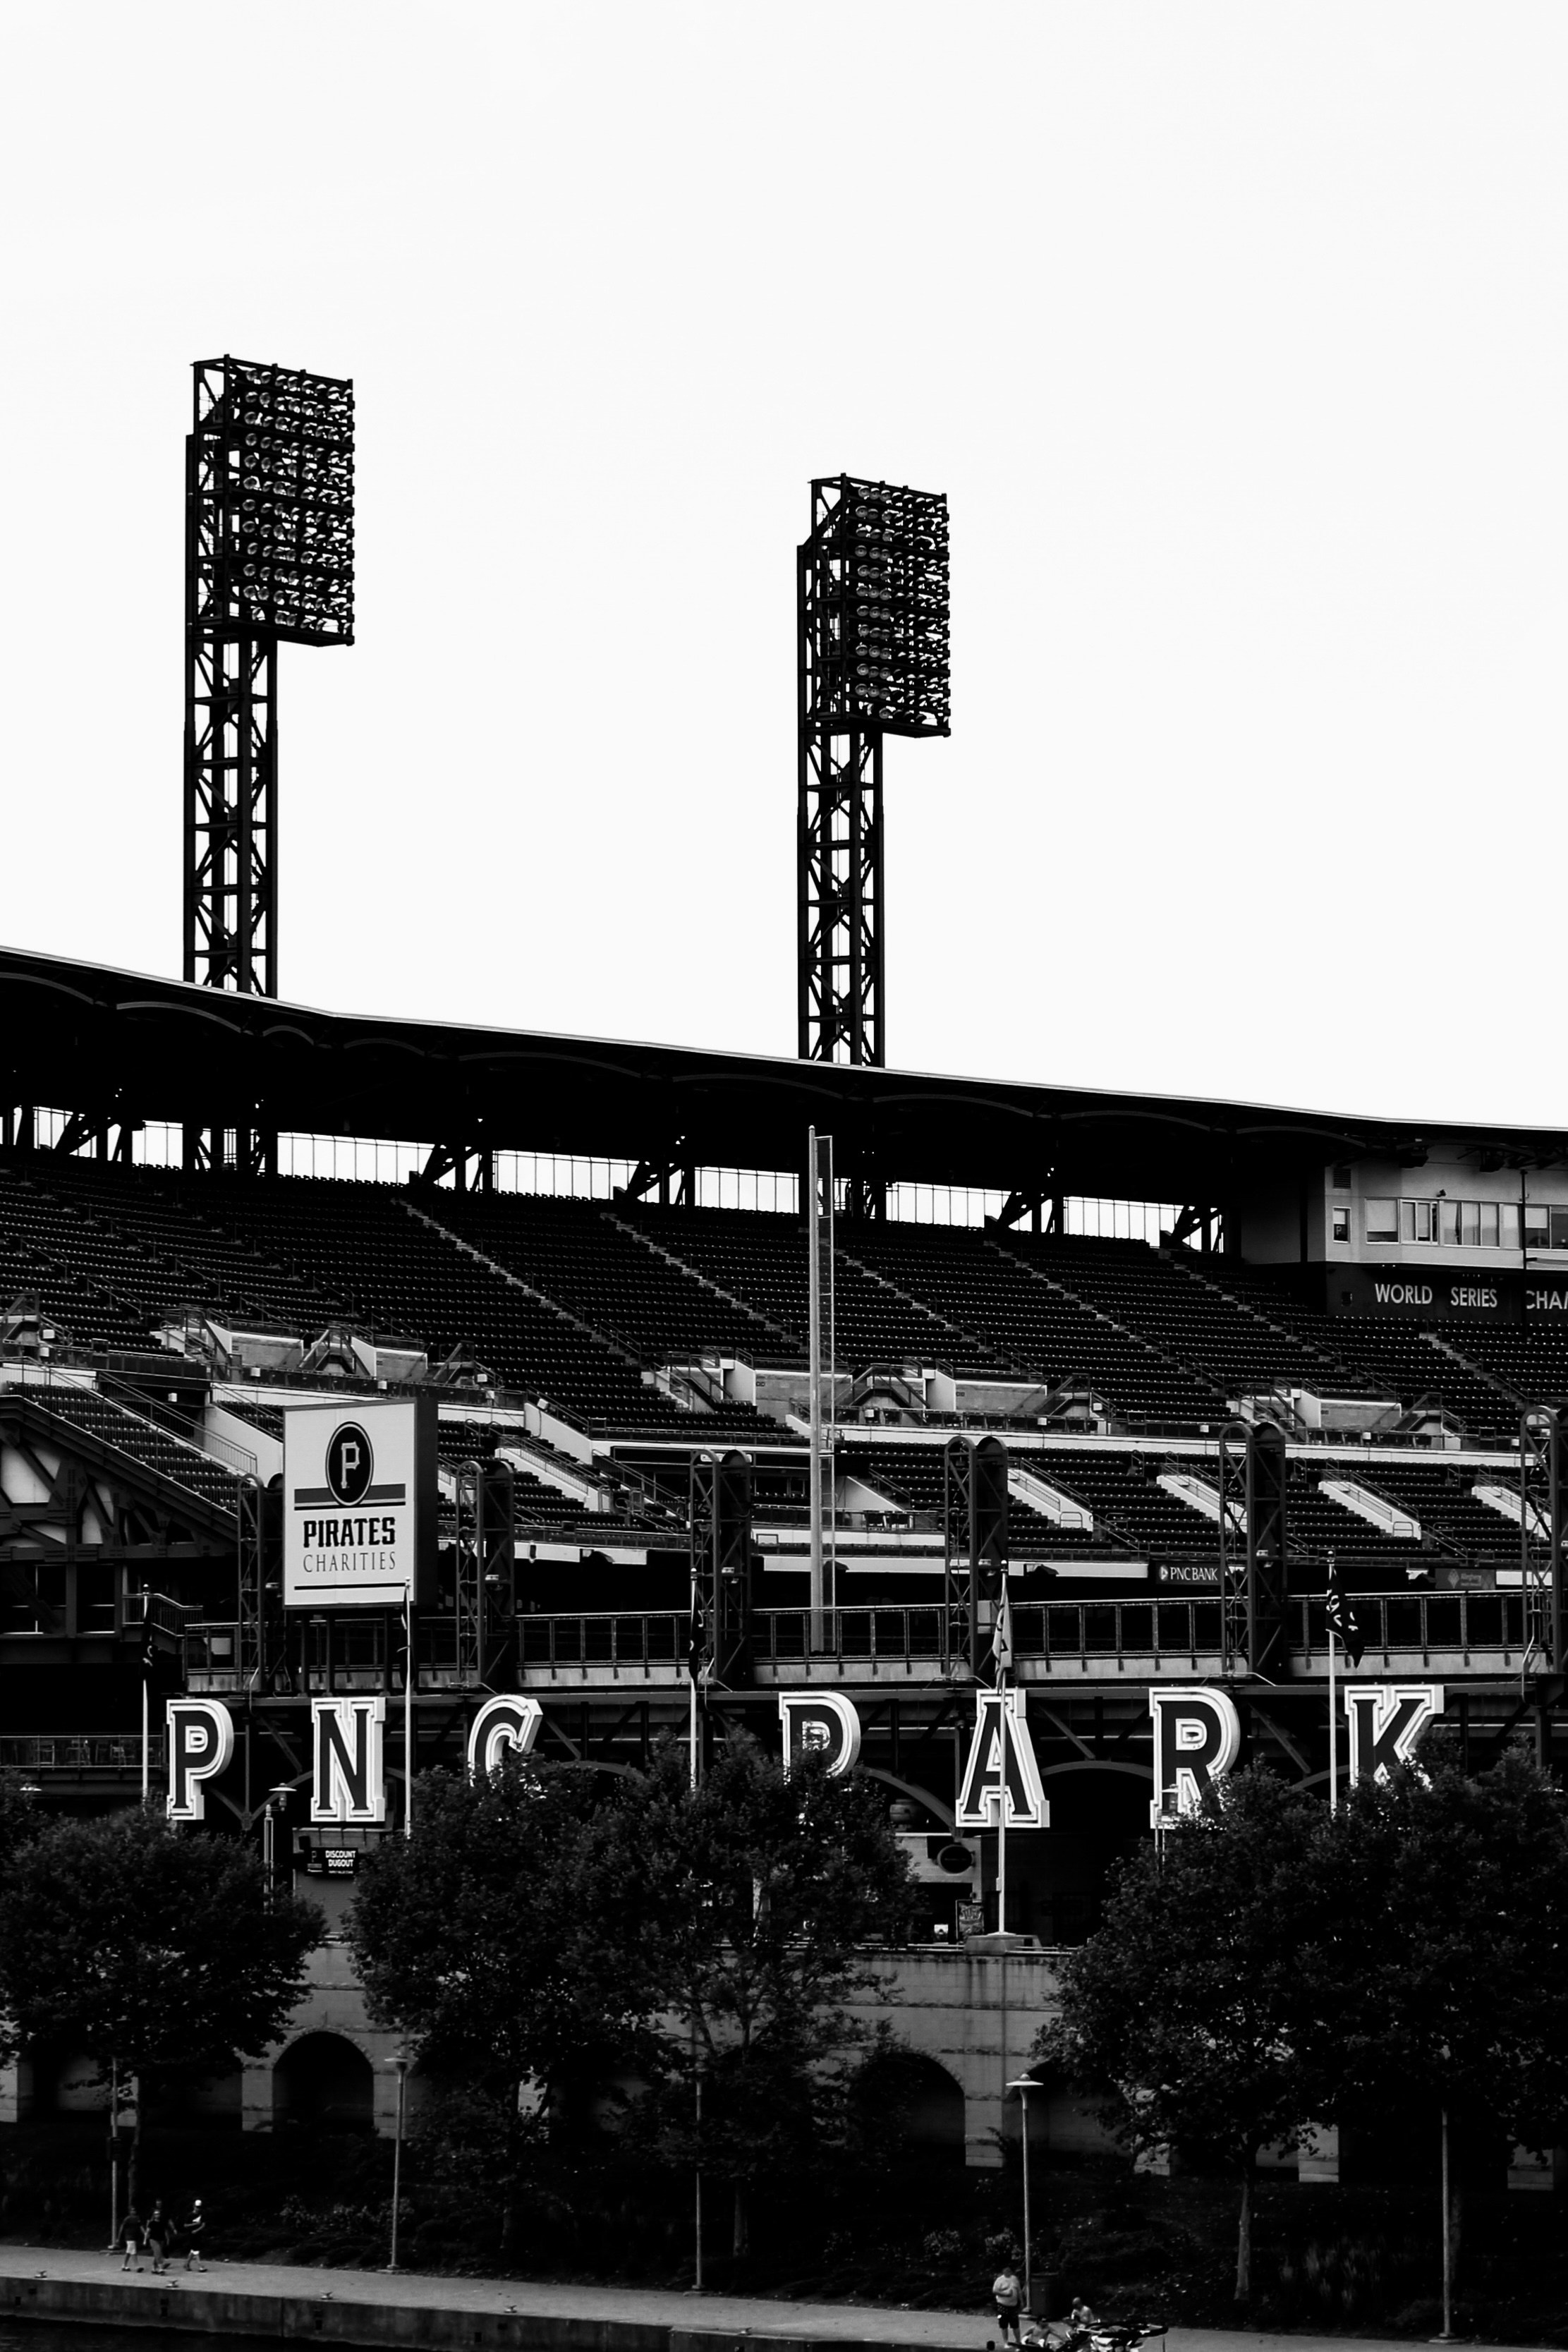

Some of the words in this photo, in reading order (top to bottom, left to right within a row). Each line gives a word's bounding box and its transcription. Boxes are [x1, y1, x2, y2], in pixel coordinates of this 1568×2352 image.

[1375, 1283, 1433, 1304] WORLD
[1450, 1287, 1498, 1308] SERIES
[1526, 1290, 1568, 1309] CHA
[340, 1441, 360, 1489] P
[303, 1517, 396, 1548] PIRATES
[303, 1551, 396, 1572] CHARITIES
[325, 1850, 355, 1858] DISCOUNT
[328, 1859, 353, 1867] DUGOUT
